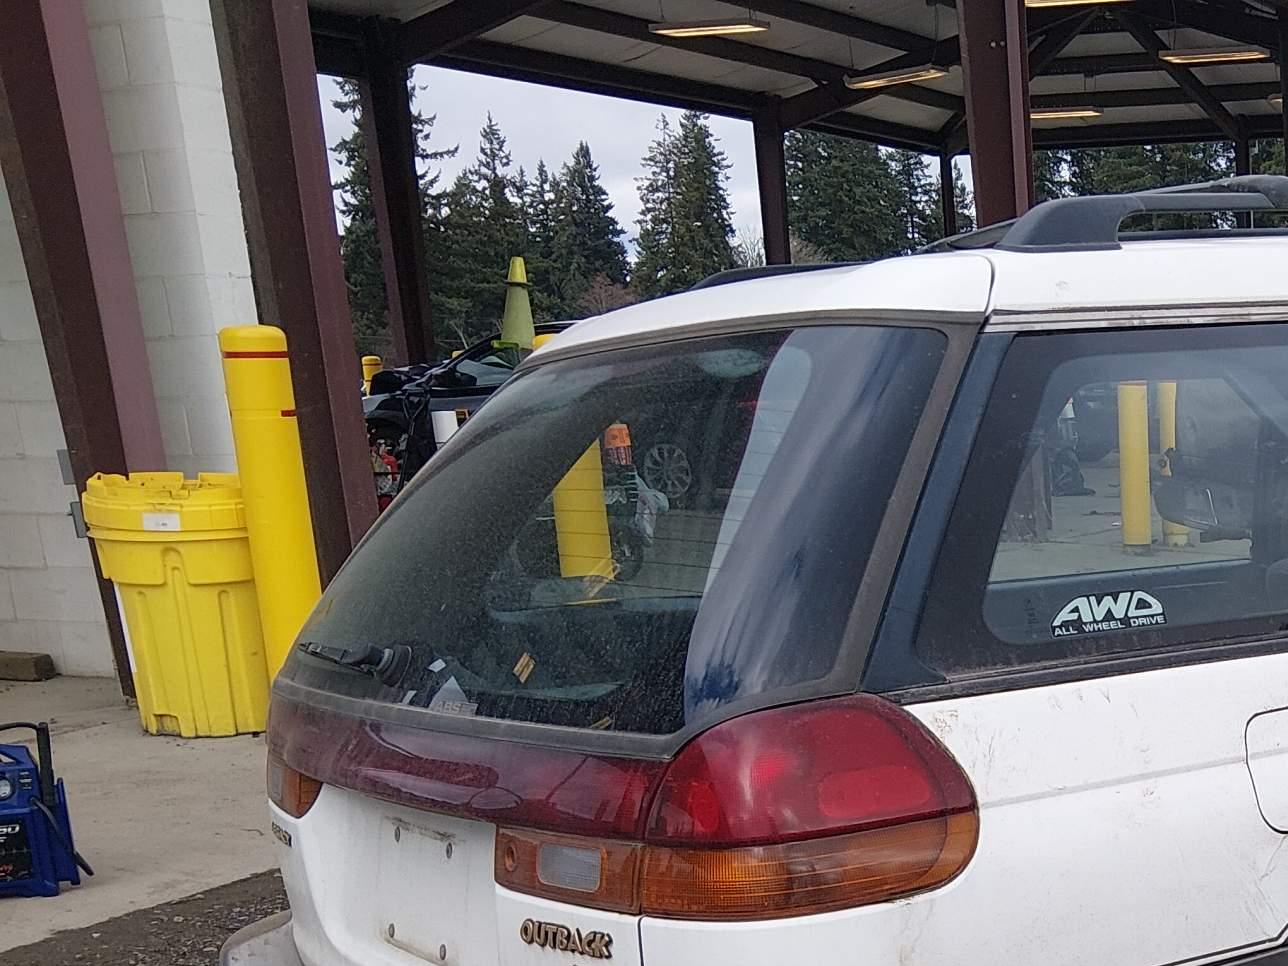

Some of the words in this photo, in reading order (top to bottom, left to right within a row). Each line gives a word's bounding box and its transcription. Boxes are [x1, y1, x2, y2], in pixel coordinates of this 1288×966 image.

[1052, 590, 1163, 626] AWD
[1054, 625, 1079, 637] ALL
[1081, 620, 1126, 633] WHEEL
[1130, 614, 1166, 627] DRIVE
[520, 918, 613, 959] OUTBACK
